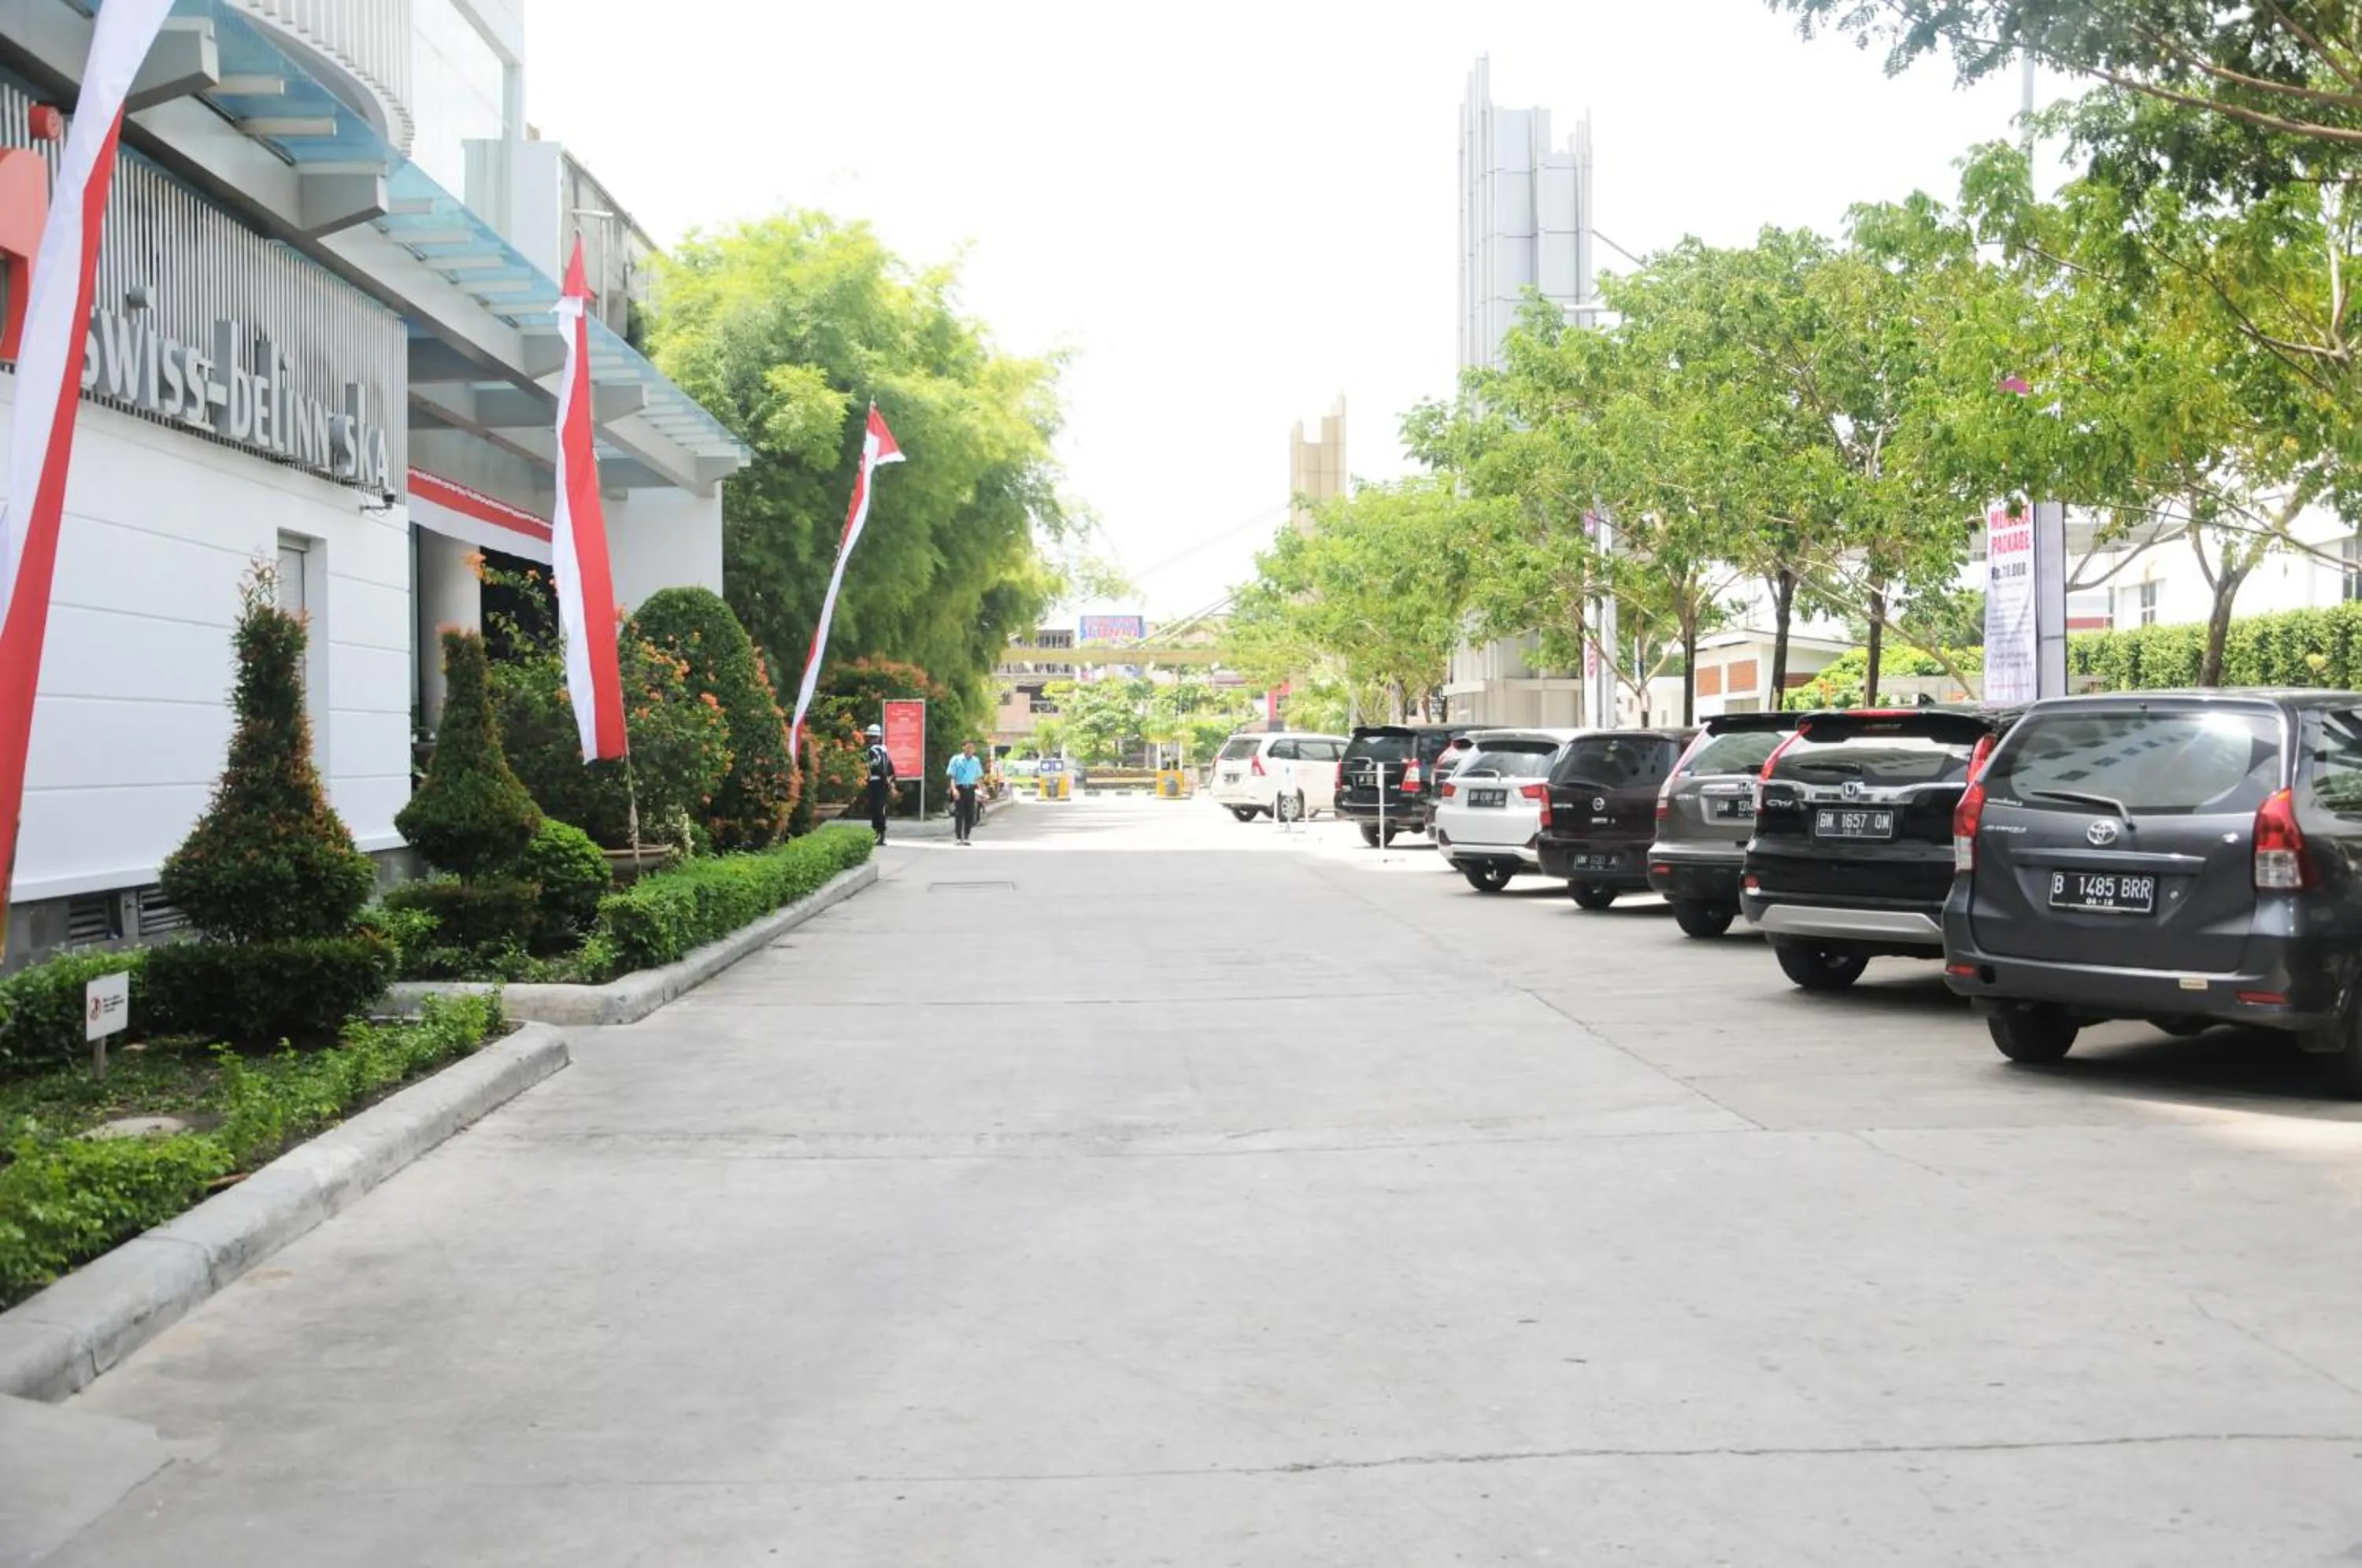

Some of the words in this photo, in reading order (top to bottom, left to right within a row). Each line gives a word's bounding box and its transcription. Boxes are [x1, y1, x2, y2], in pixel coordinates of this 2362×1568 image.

[343, 381, 390, 490] SKA
[1842, 813, 1868, 829] 1657
[2053, 875, 2064, 893] B
[2079, 876, 2116, 897] 1485
[2120, 878, 2151, 899] BRR
